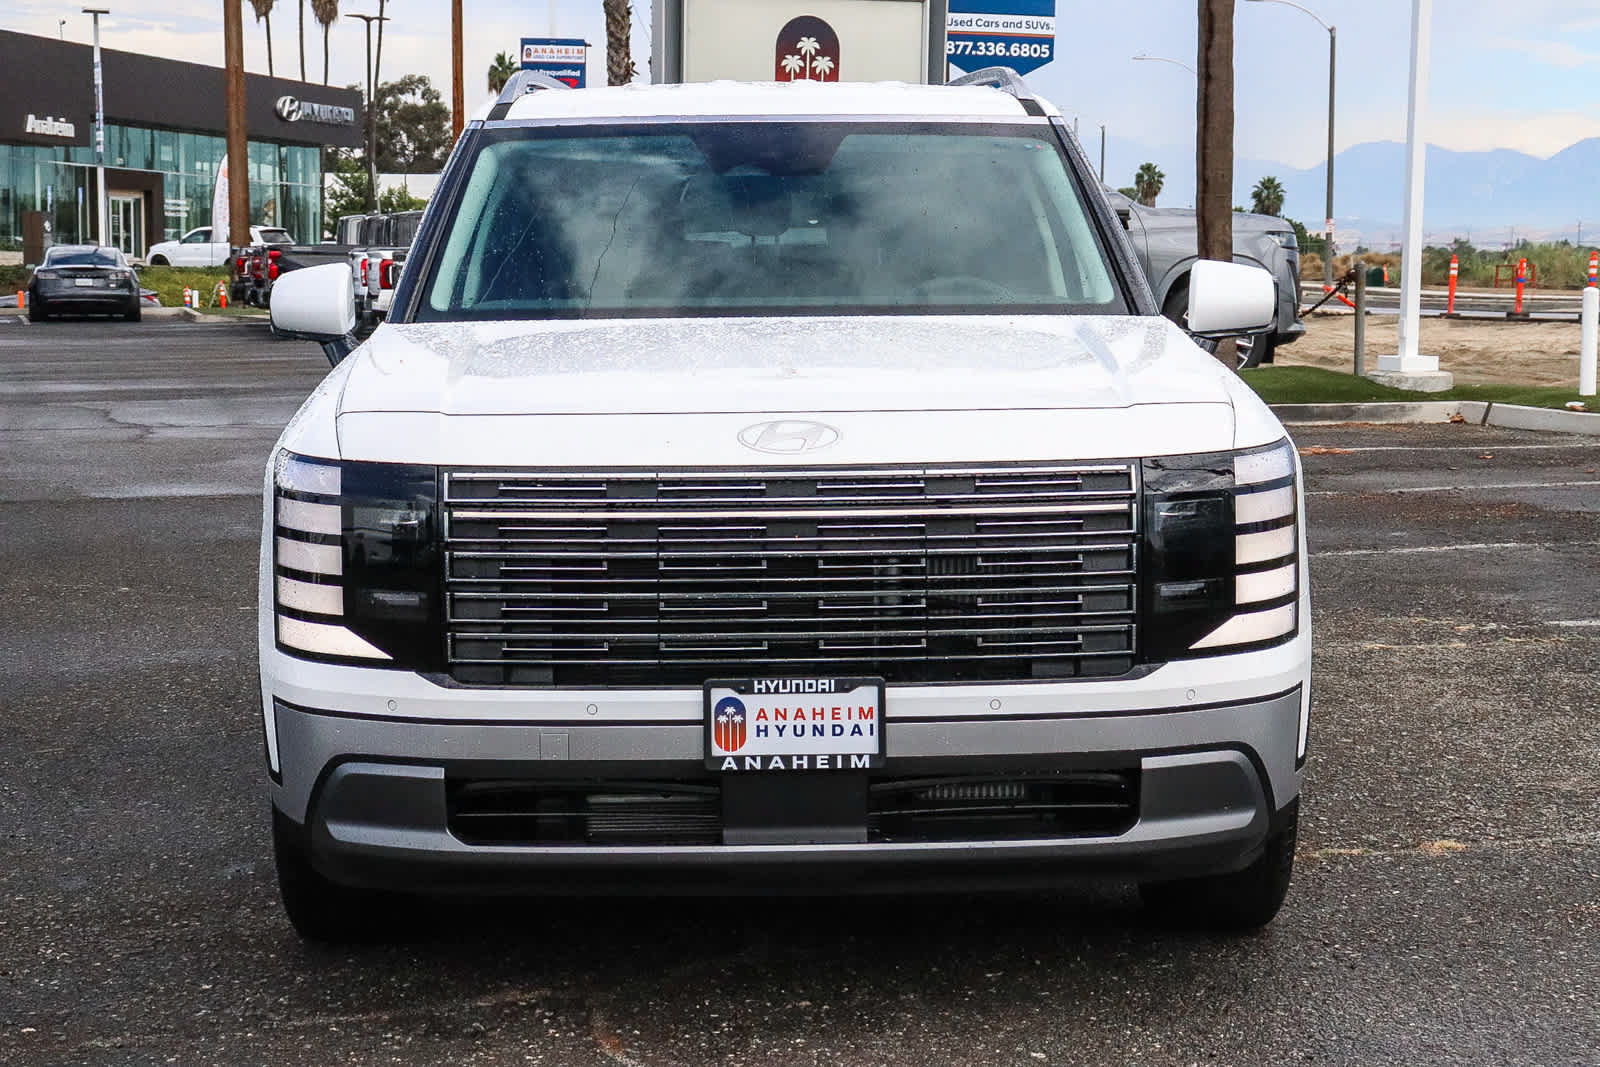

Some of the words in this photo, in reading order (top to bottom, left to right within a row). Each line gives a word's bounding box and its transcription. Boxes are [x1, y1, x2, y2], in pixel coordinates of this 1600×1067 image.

[975, 18, 1000, 28] Cars
[1002, 19, 1022, 29] and
[533, 47, 584, 55] ANAHEIM
[946, 41, 1050, 58] 877.336.6805
[753, 679, 835, 693] HYUNDAI
[755, 706, 874, 721] ANAHEIM
[755, 723, 874, 738] HYUNDAI
[720, 754, 871, 771] ANAHEIM
